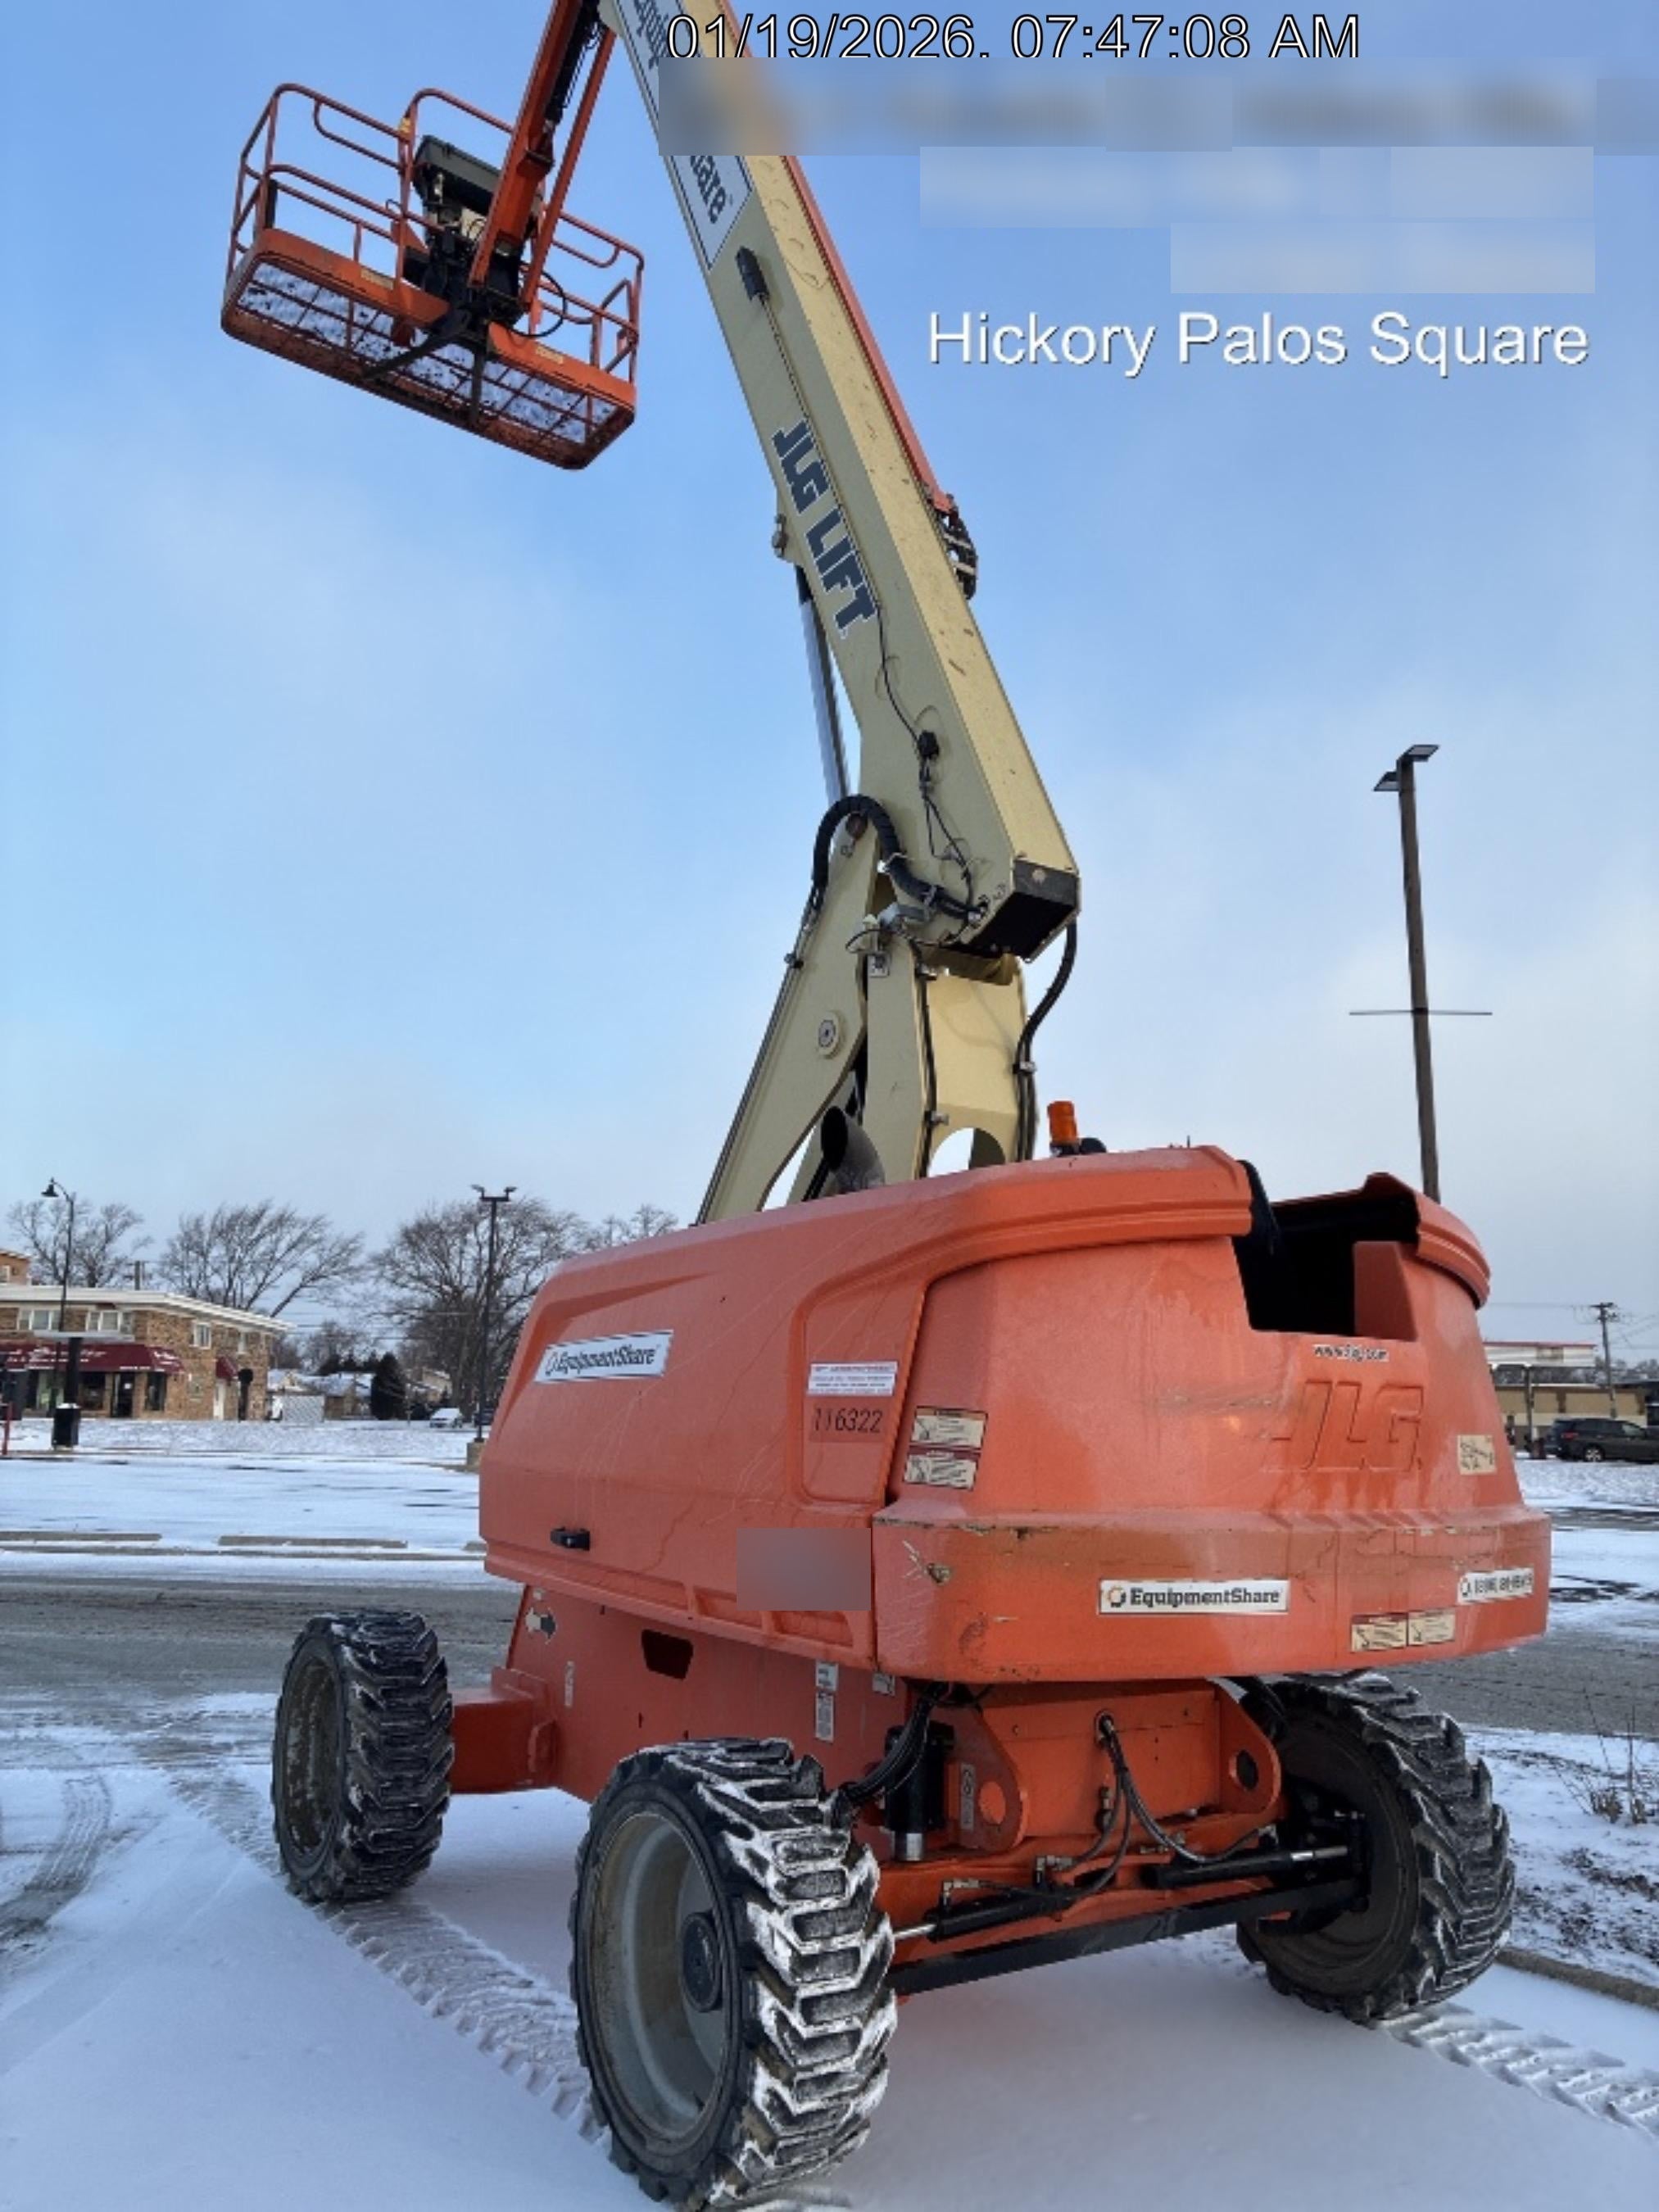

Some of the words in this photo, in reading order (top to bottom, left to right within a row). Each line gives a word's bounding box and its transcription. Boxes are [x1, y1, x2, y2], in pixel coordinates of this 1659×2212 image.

[771, 419, 830, 514] JLG
[805, 505, 877, 630] LIFT
[1270, 1379, 1424, 1473] JLG
[1130, 1586, 1280, 1608] EquipmentShare
